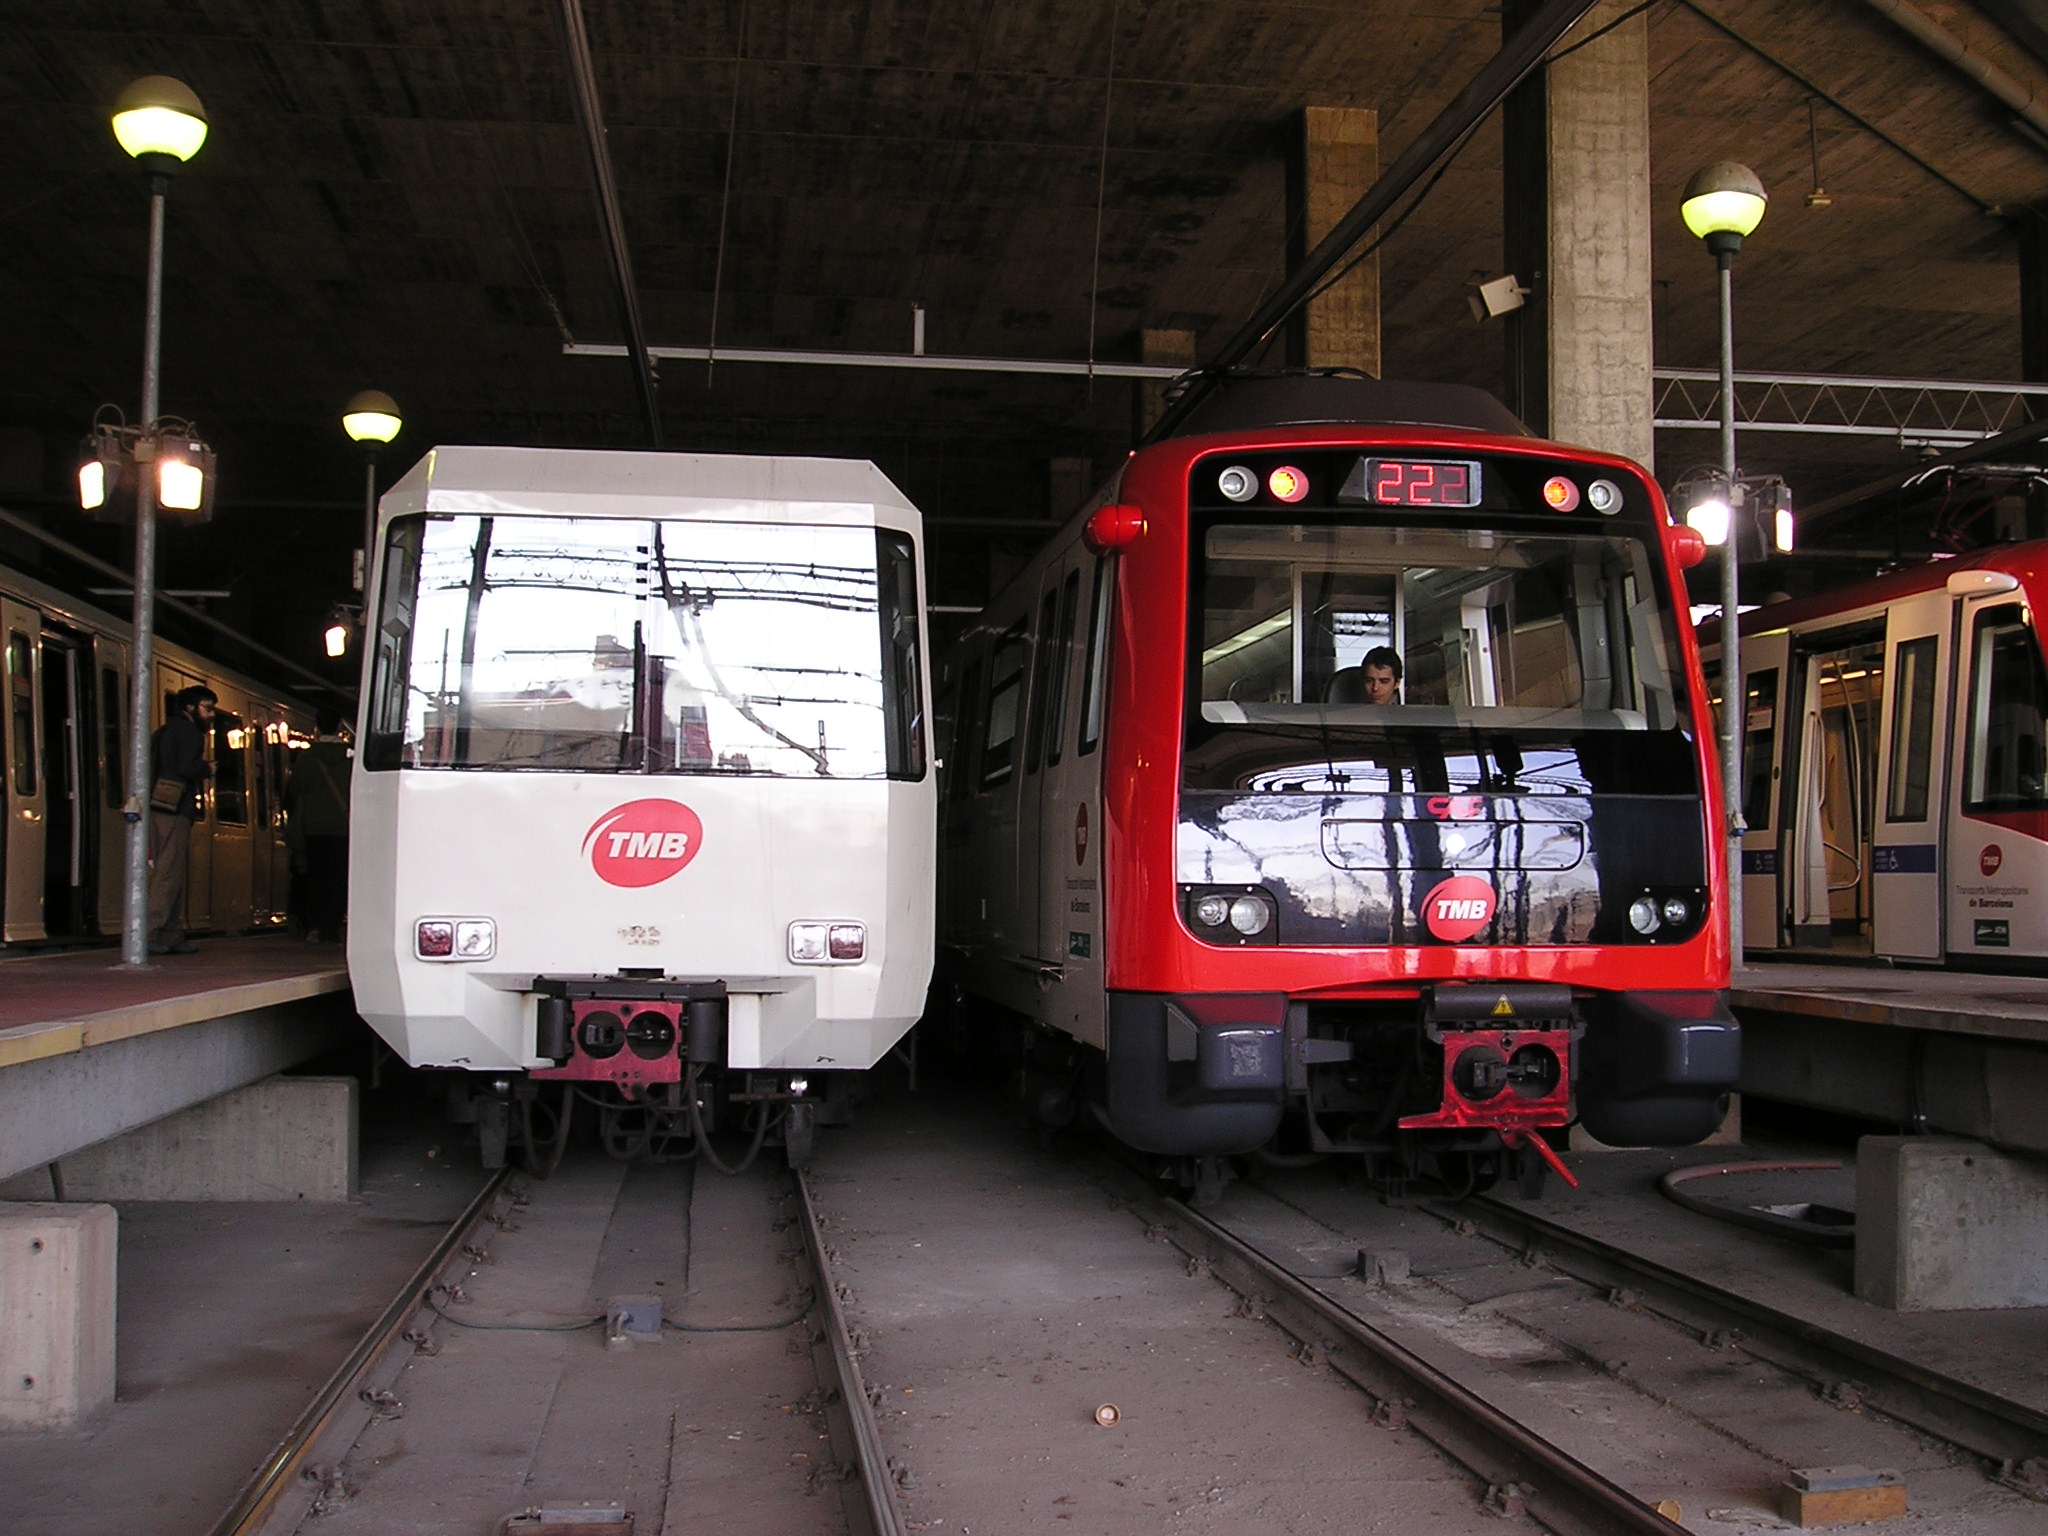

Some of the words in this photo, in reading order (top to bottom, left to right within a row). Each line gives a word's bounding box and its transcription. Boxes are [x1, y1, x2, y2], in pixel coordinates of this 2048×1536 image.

[1377, 463, 1465, 504] 222
[607, 831, 688, 859] TMB
[1437, 900, 1488, 920] TMB
